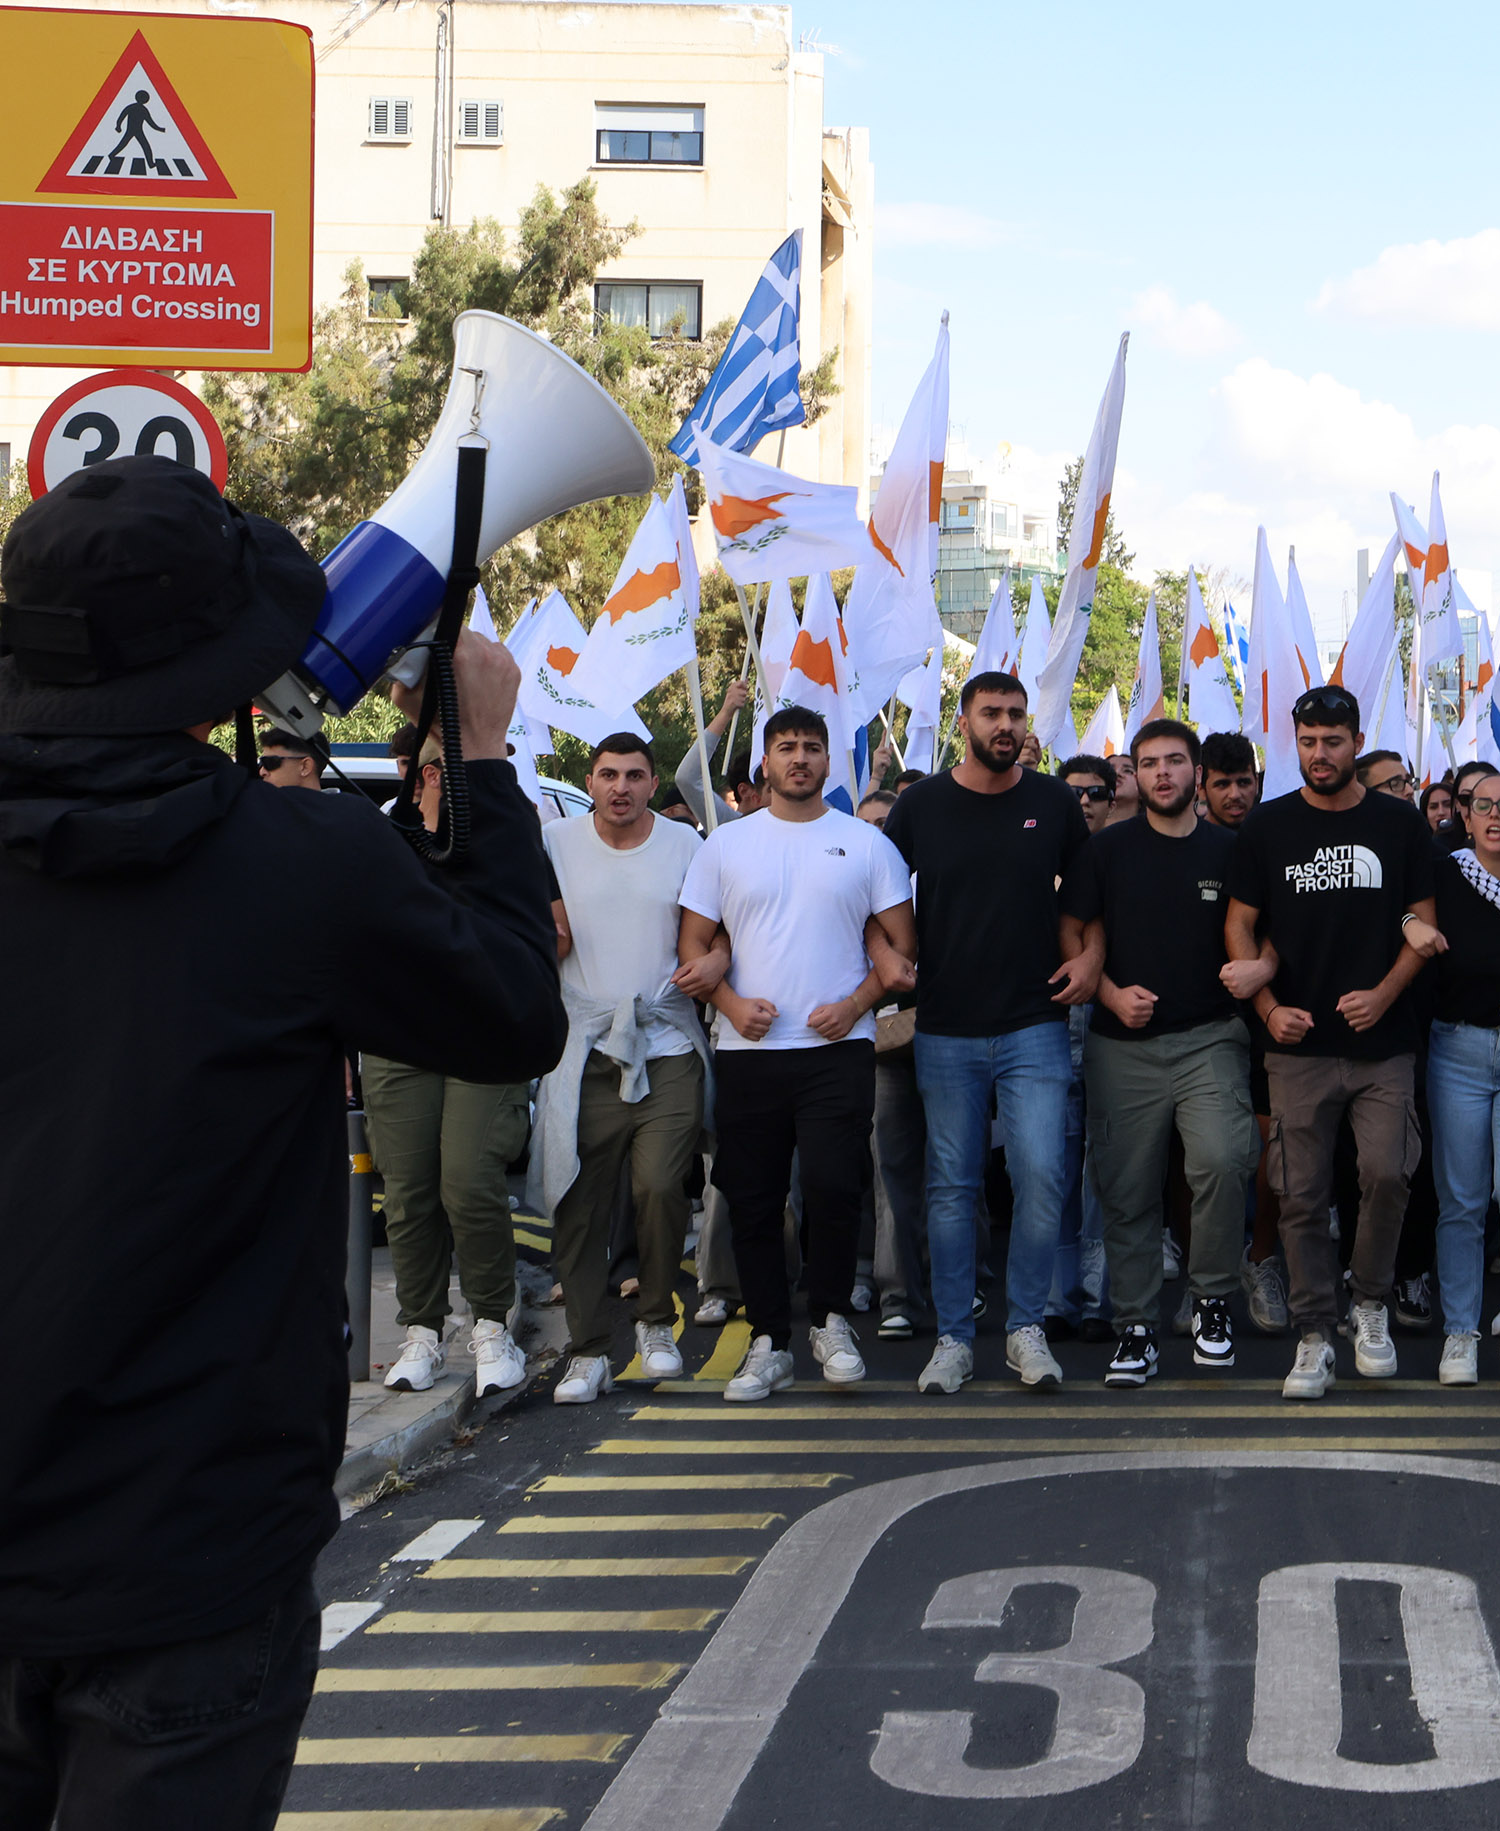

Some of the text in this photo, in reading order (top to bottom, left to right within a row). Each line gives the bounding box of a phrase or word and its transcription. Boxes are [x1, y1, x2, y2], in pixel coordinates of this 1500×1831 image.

[60, 226, 203, 253] ΔΙΑΒΑΣΗ
[27, 257, 236, 287] ΣΕ ΚΥΡΤΩΜΑ
[0, 291, 260, 327] Humped Crossing
[62, 411, 196, 468] 30
[1313, 844, 1352, 862] ANTI
[1285, 859, 1353, 881] FASCIST
[1295, 873, 1353, 894] FRONT
